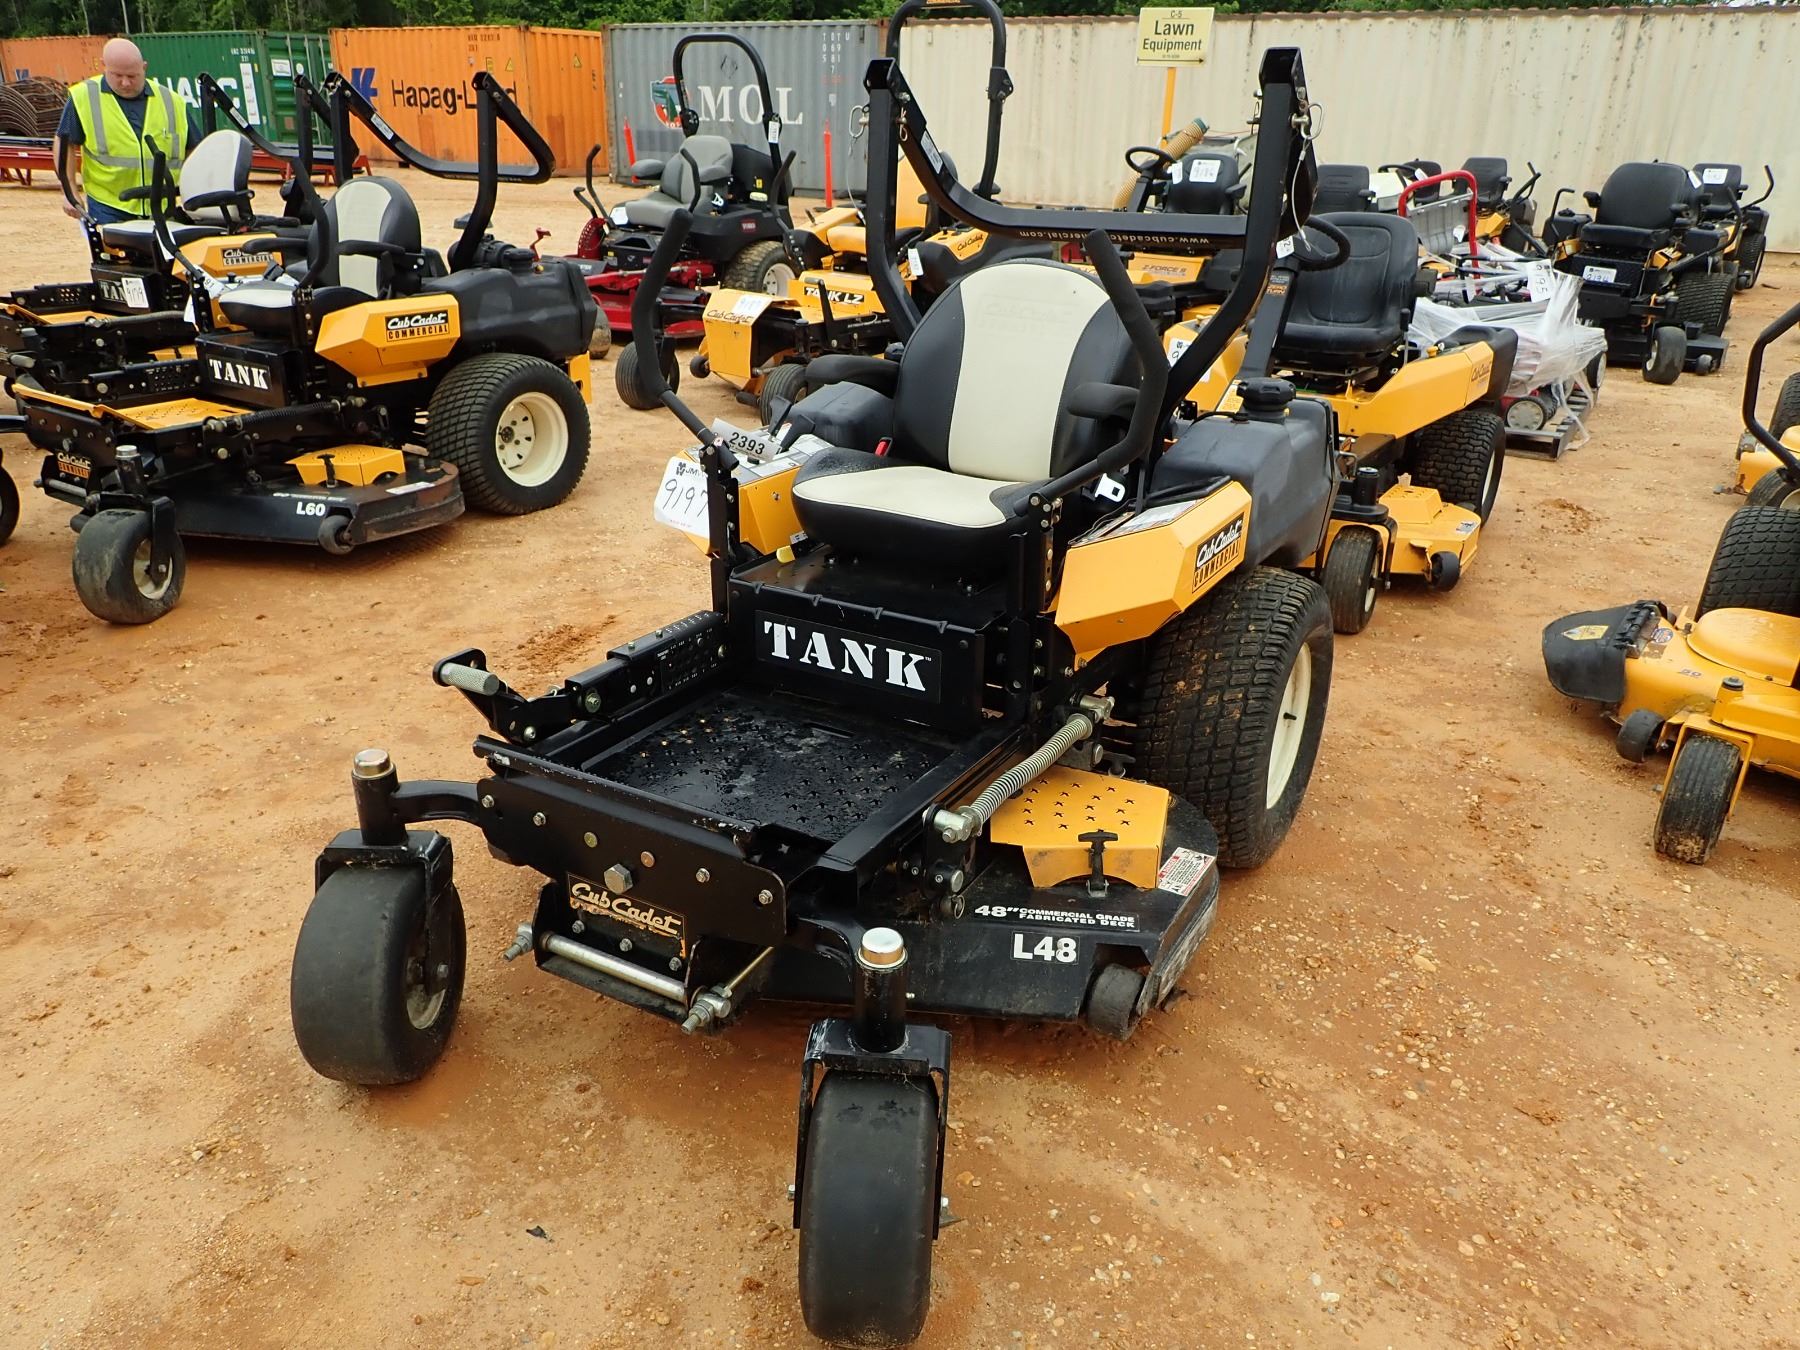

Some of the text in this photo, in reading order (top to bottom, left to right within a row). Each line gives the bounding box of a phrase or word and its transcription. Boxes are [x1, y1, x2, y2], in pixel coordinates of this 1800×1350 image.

[1170, 10, 1183, 18] C-5
[1154, 20, 1195, 35] Lawn
[1143, 38, 1202, 53] Equipment
[698, 84, 804, 125] MOL
[224, 249, 241, 258] Cub
[101, 281, 127, 301] TAN
[843, 293, 864, 304] LZ
[387, 312, 447, 330] Cub Cadet
[388, 324, 449, 340] COMMERCIAL
[209, 358, 269, 390] TANK
[729, 431, 766, 456] 2393
[296, 501, 326, 516] L60
[1196, 519, 1243, 568] Cub Cadet
[1193, 539, 1241, 588] COMMERCIAL
[764, 621, 926, 692] TANK
[571, 882, 682, 935] Cub Cadet
[1019, 907, 1093, 919] COMMERCIAL
[1095, 913, 1135, 923] GRADE
[1018, 914, 1135, 928] FABRICATED DECK
[1013, 933, 1077, 963] L48
